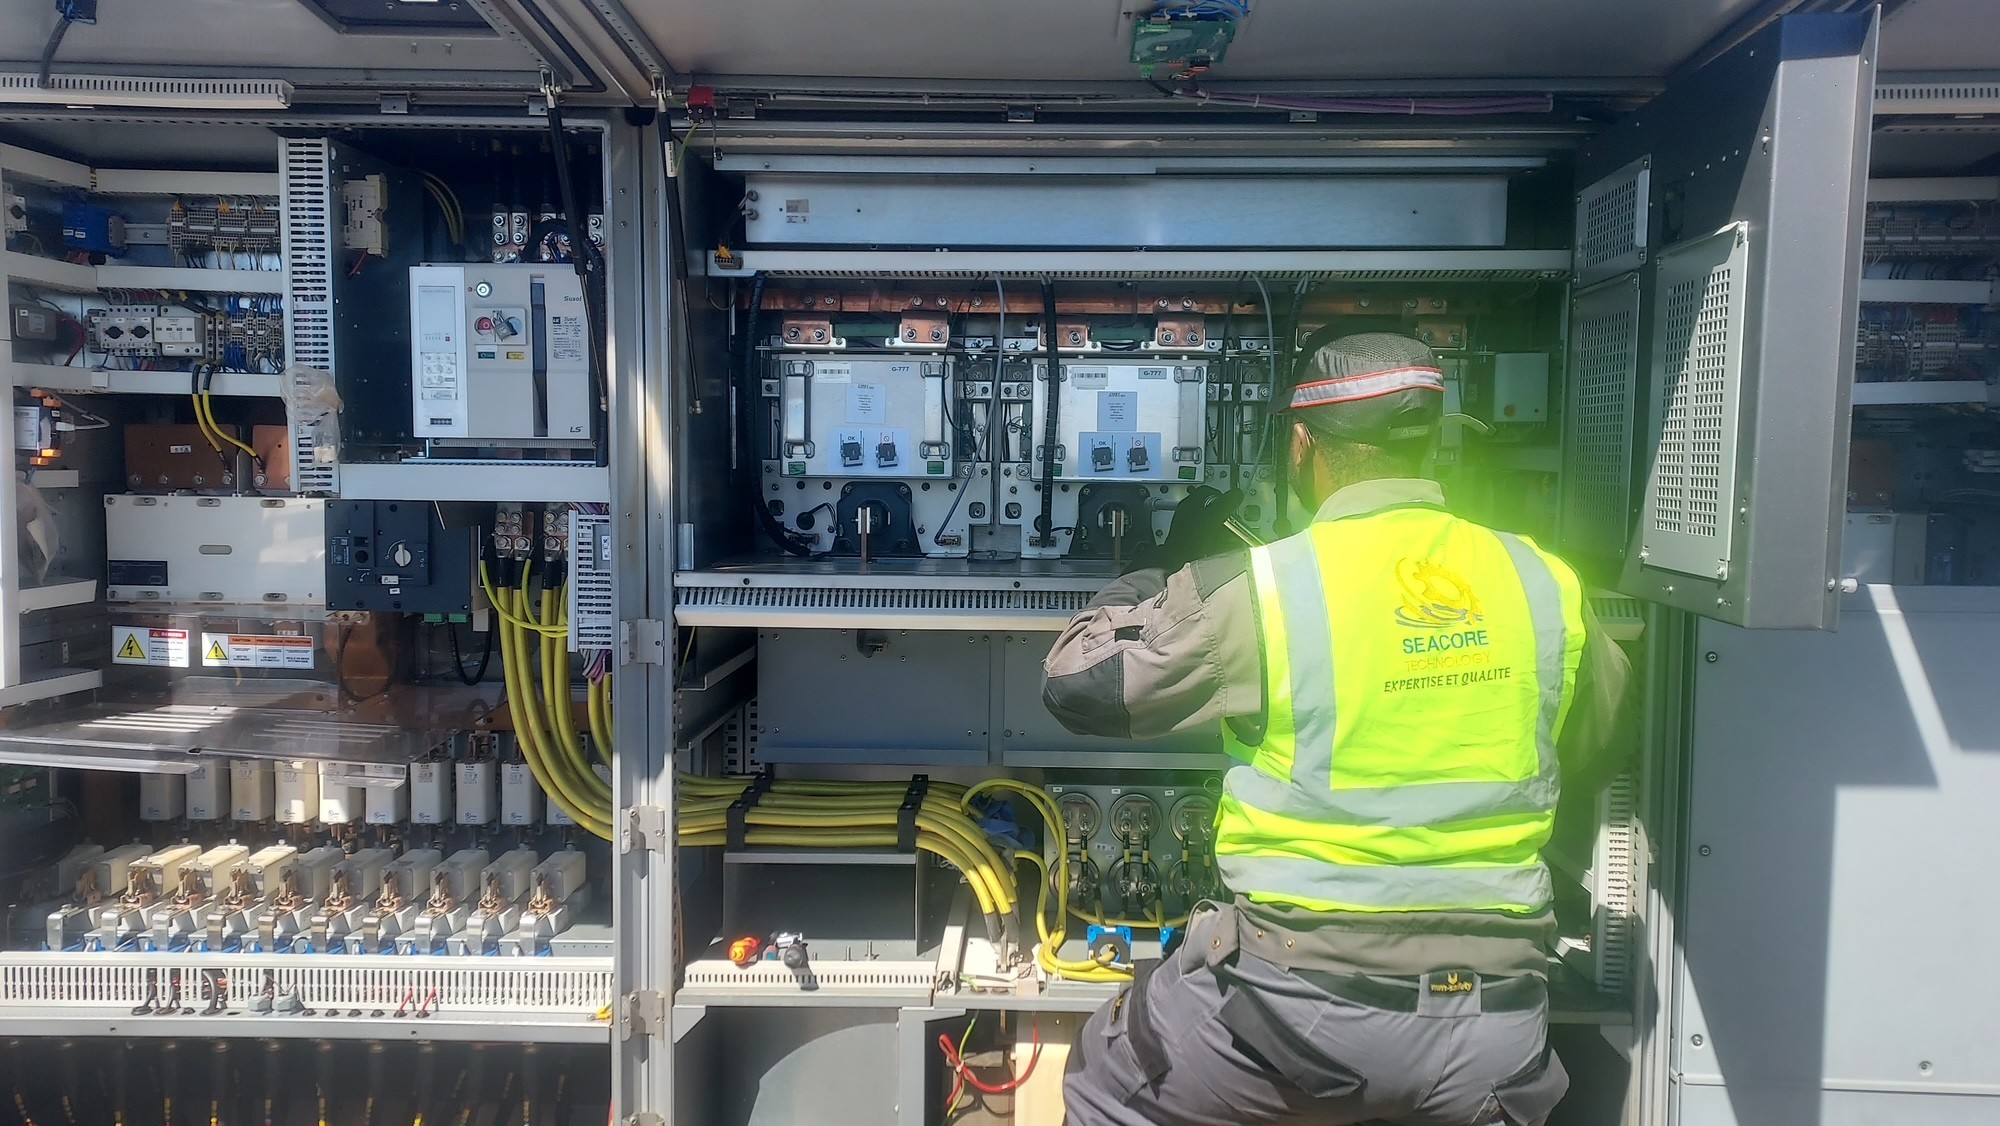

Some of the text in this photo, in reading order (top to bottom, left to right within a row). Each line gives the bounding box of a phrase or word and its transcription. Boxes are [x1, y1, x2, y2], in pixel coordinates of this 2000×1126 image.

[1402, 629, 1489, 654] SEACORE
[1404, 651, 1491, 673] TECHNOLOGY
[1384, 667, 1511, 692] EXPERTISE ET QUALITE
